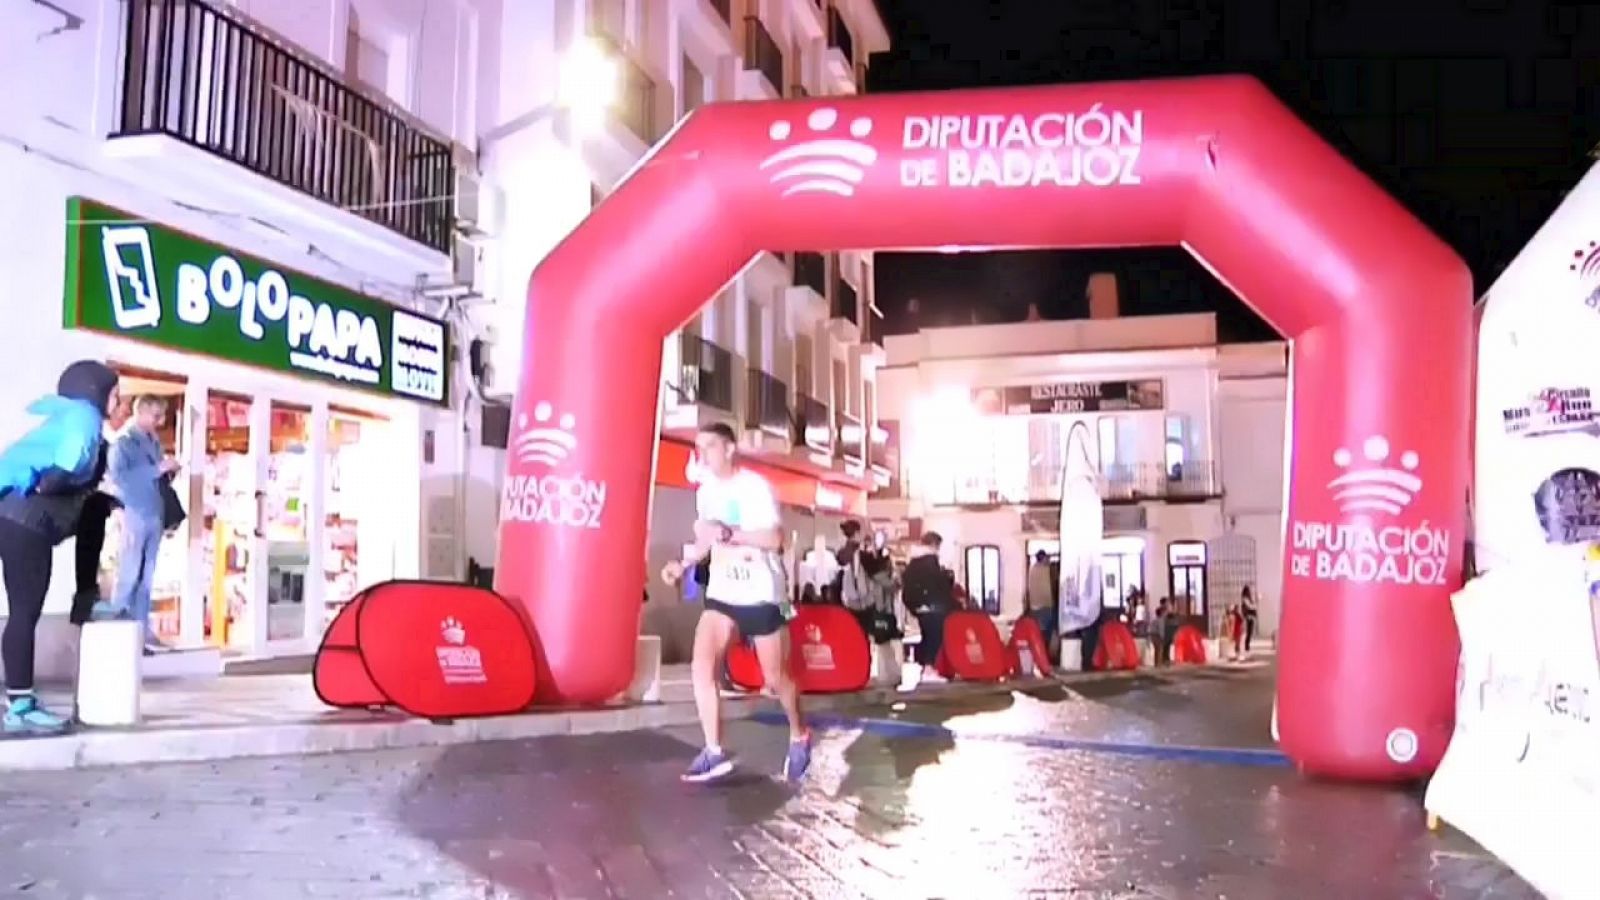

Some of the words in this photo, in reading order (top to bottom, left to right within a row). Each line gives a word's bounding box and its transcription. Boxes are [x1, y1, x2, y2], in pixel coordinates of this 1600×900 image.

[903, 103, 1143, 148] DIPUTACIÓN
[901, 159, 937, 186] DE
[948, 146, 1142, 187] BADAJOZ
[1051, 398, 1085, 413] JERO
[1293, 520, 1449, 557] DIPUTACIÓN
[1291, 554, 1311, 577] DE
[1316, 550, 1448, 585] BADAJOZ
